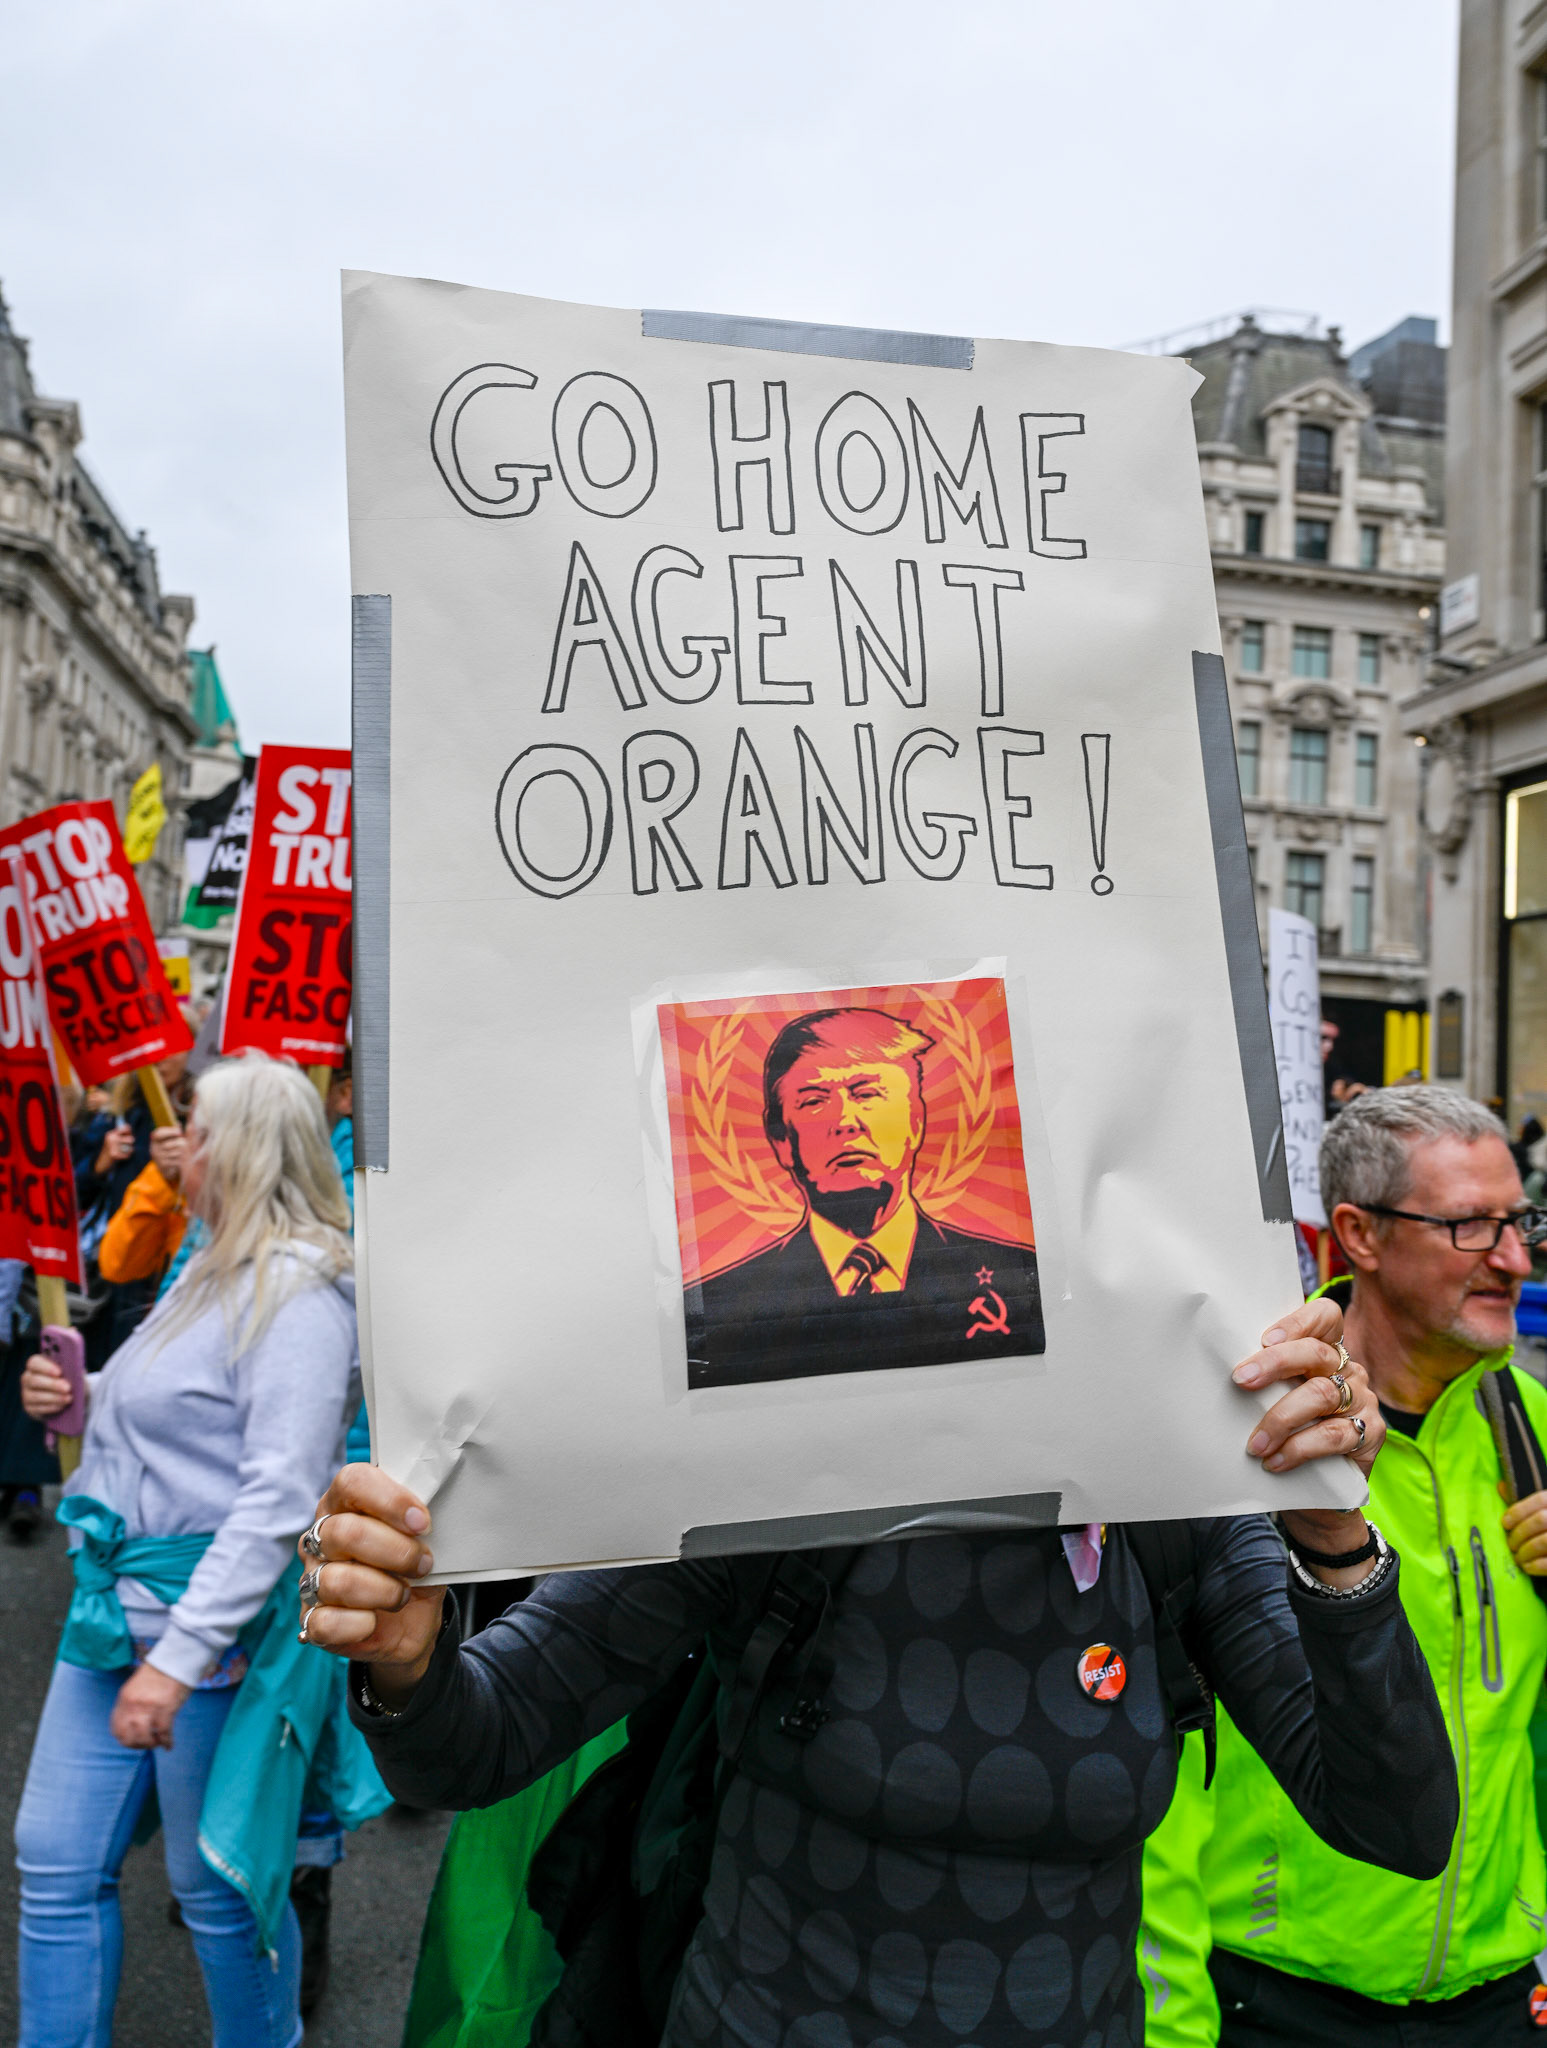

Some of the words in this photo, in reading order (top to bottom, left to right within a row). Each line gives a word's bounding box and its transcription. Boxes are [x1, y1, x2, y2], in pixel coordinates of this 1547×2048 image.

[430, 363, 658, 518] GO
[708, 380, 1088, 559] HOME
[541, 540, 1025, 717] AGENT
[271, 764, 352, 836] ST
[269, 831, 352, 892] TRU
[252, 908, 352, 985] ST
[65, 992, 171, 1057] FASCI
[243, 978, 350, 1028] FASC
[1084, 1663, 1121, 1683] RESIST
